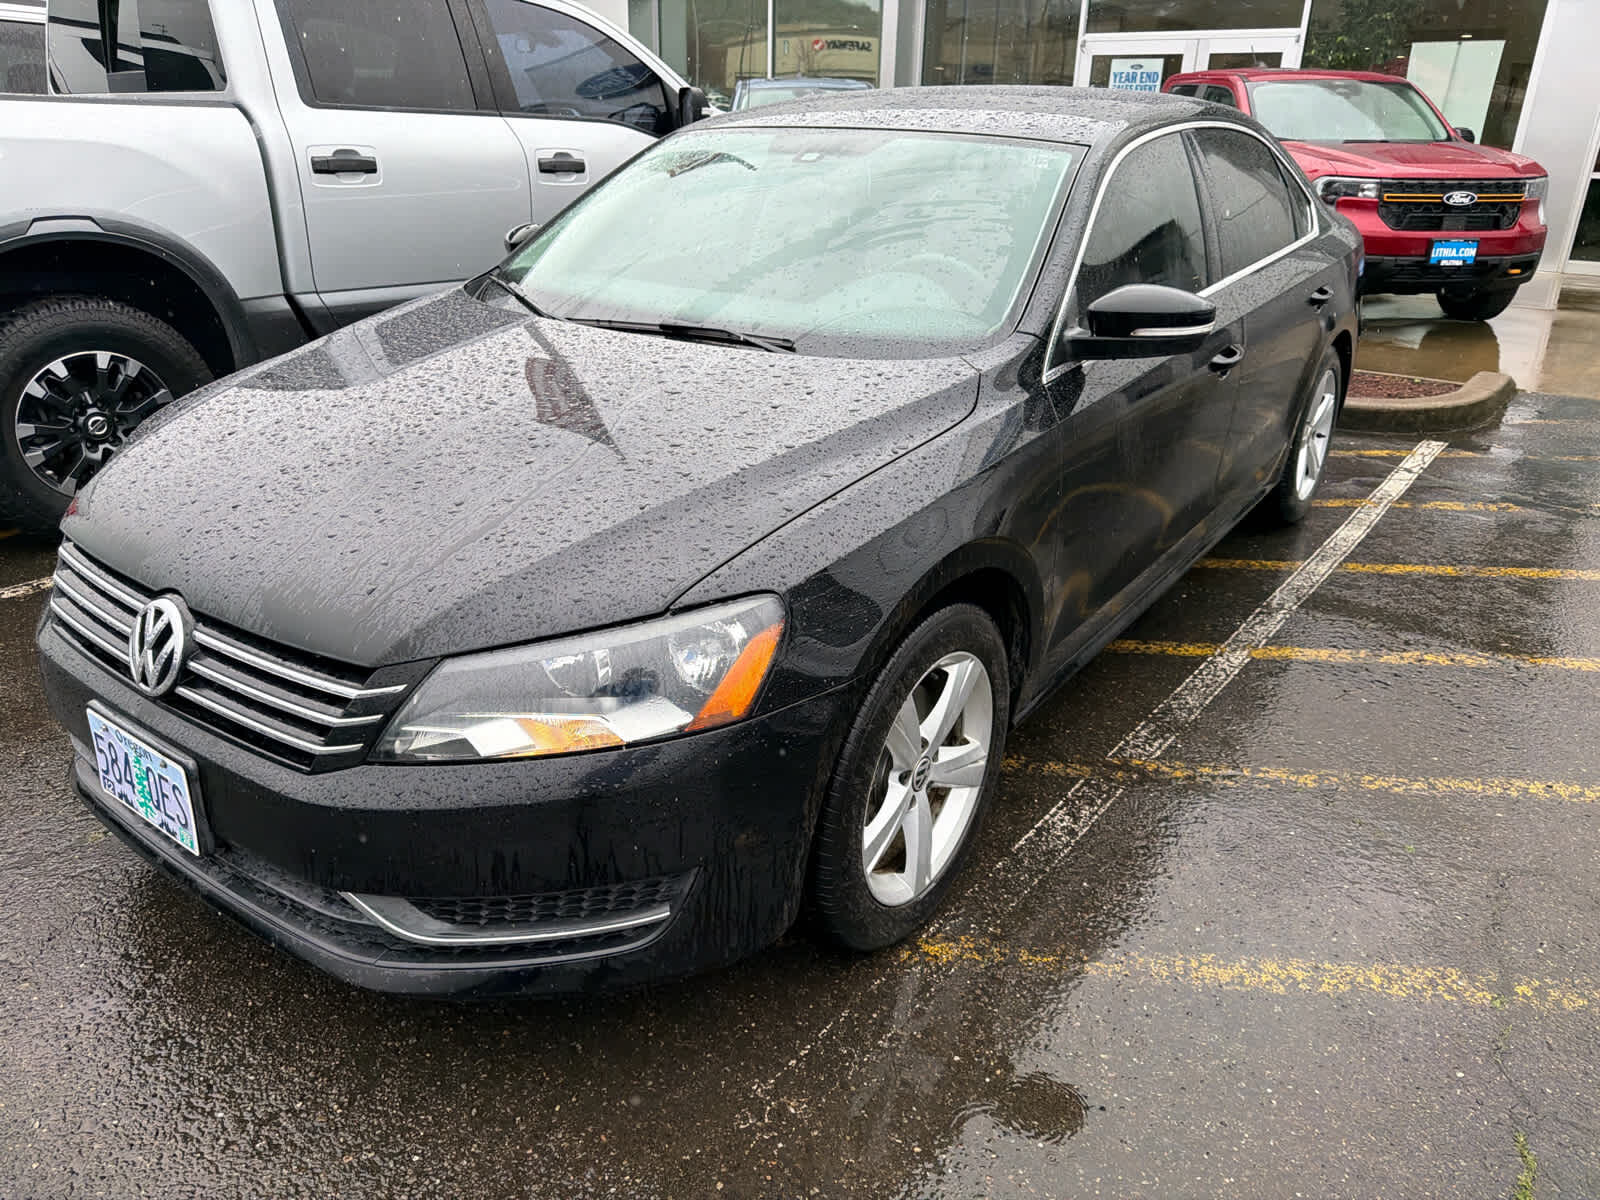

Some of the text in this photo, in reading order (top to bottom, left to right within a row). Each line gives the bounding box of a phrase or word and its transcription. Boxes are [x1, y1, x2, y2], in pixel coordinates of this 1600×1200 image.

[1112, 72, 1159, 84] YEAR END
[1431, 247, 1478, 257] LITHIA.COM
[114, 729, 154, 763] Oregon
[94, 731, 136, 795] 584
